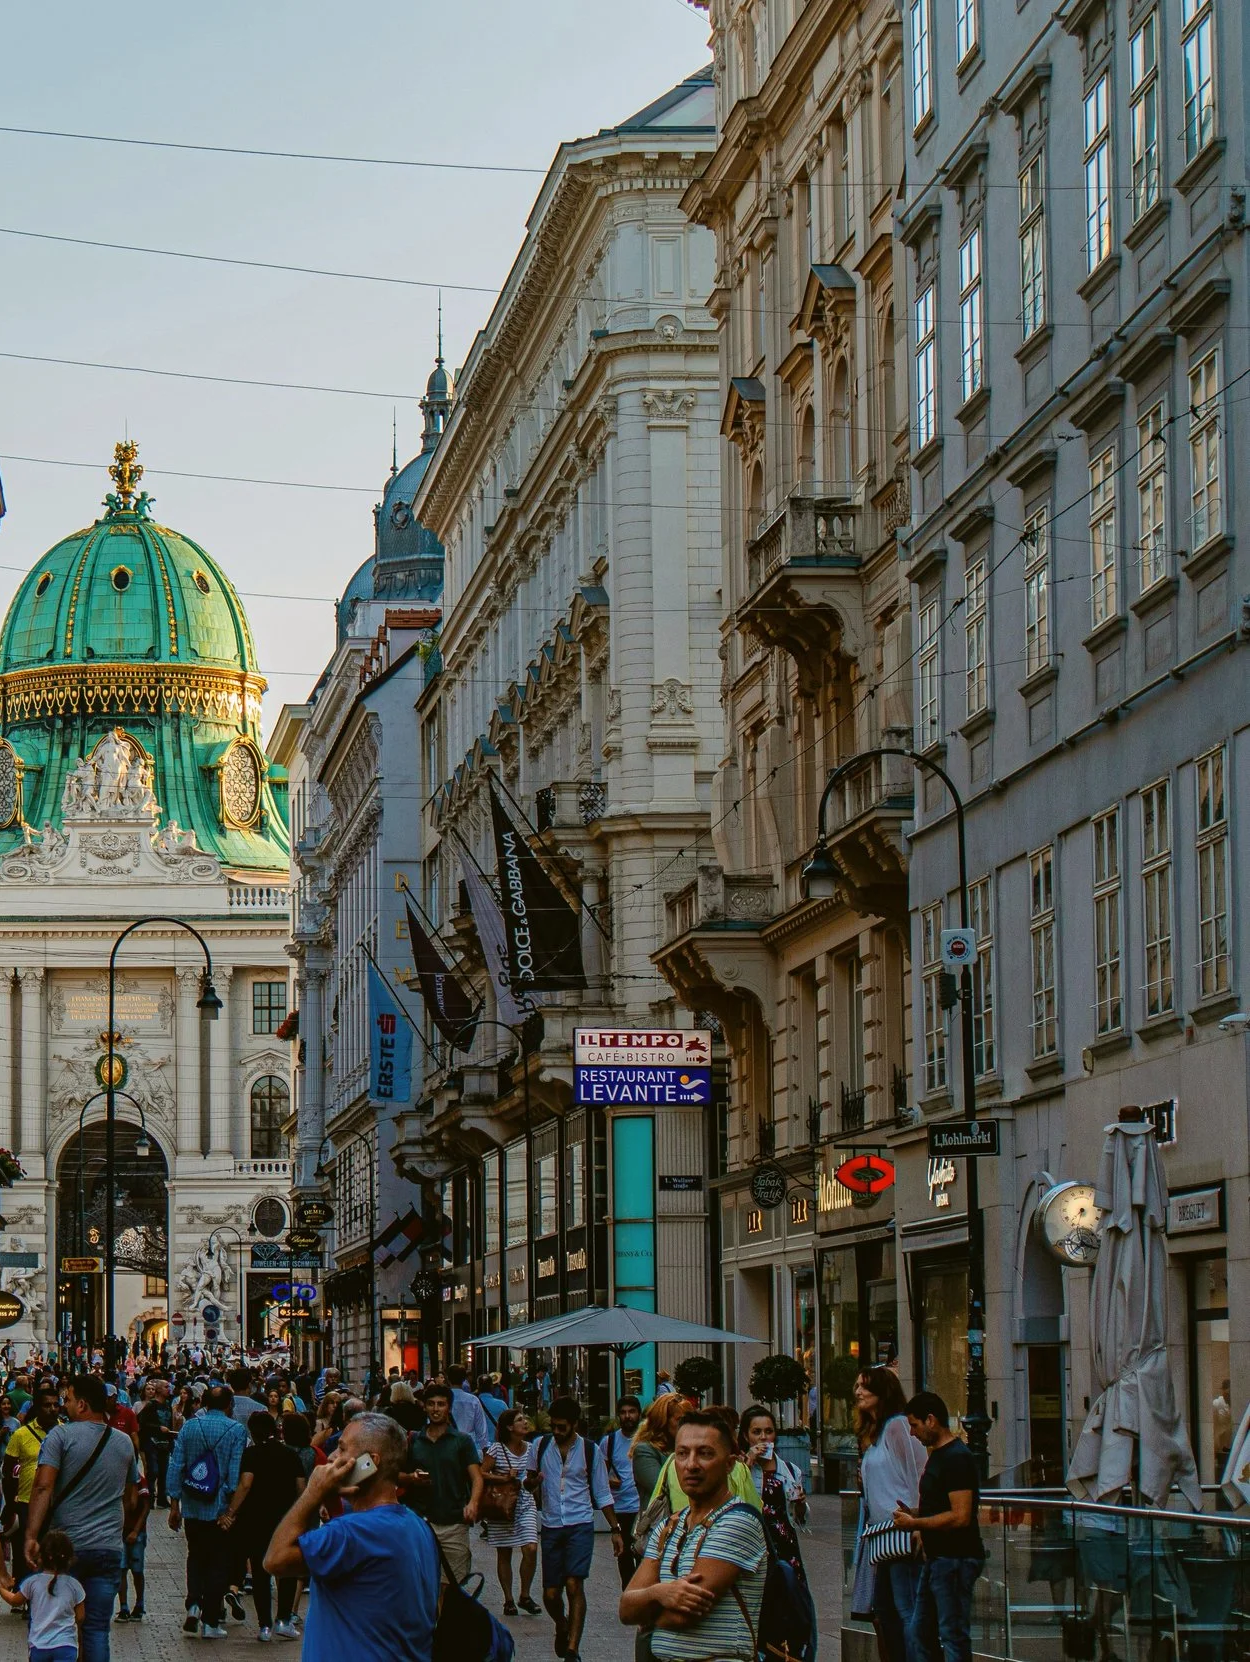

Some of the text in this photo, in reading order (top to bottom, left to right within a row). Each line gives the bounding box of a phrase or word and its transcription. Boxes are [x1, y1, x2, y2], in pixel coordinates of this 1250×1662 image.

[502, 831, 527, 917] GABBANA
[579, 1035, 681, 1046] IL TEMPO
[377, 1037, 396, 1099] ERSTE
[580, 1070, 676, 1082] RESTAURANT
[580, 1084, 677, 1102] LEVANTE
[754, 1175, 784, 1189] Tabak
[1178, 1202, 1205, 1222] BREGUET
